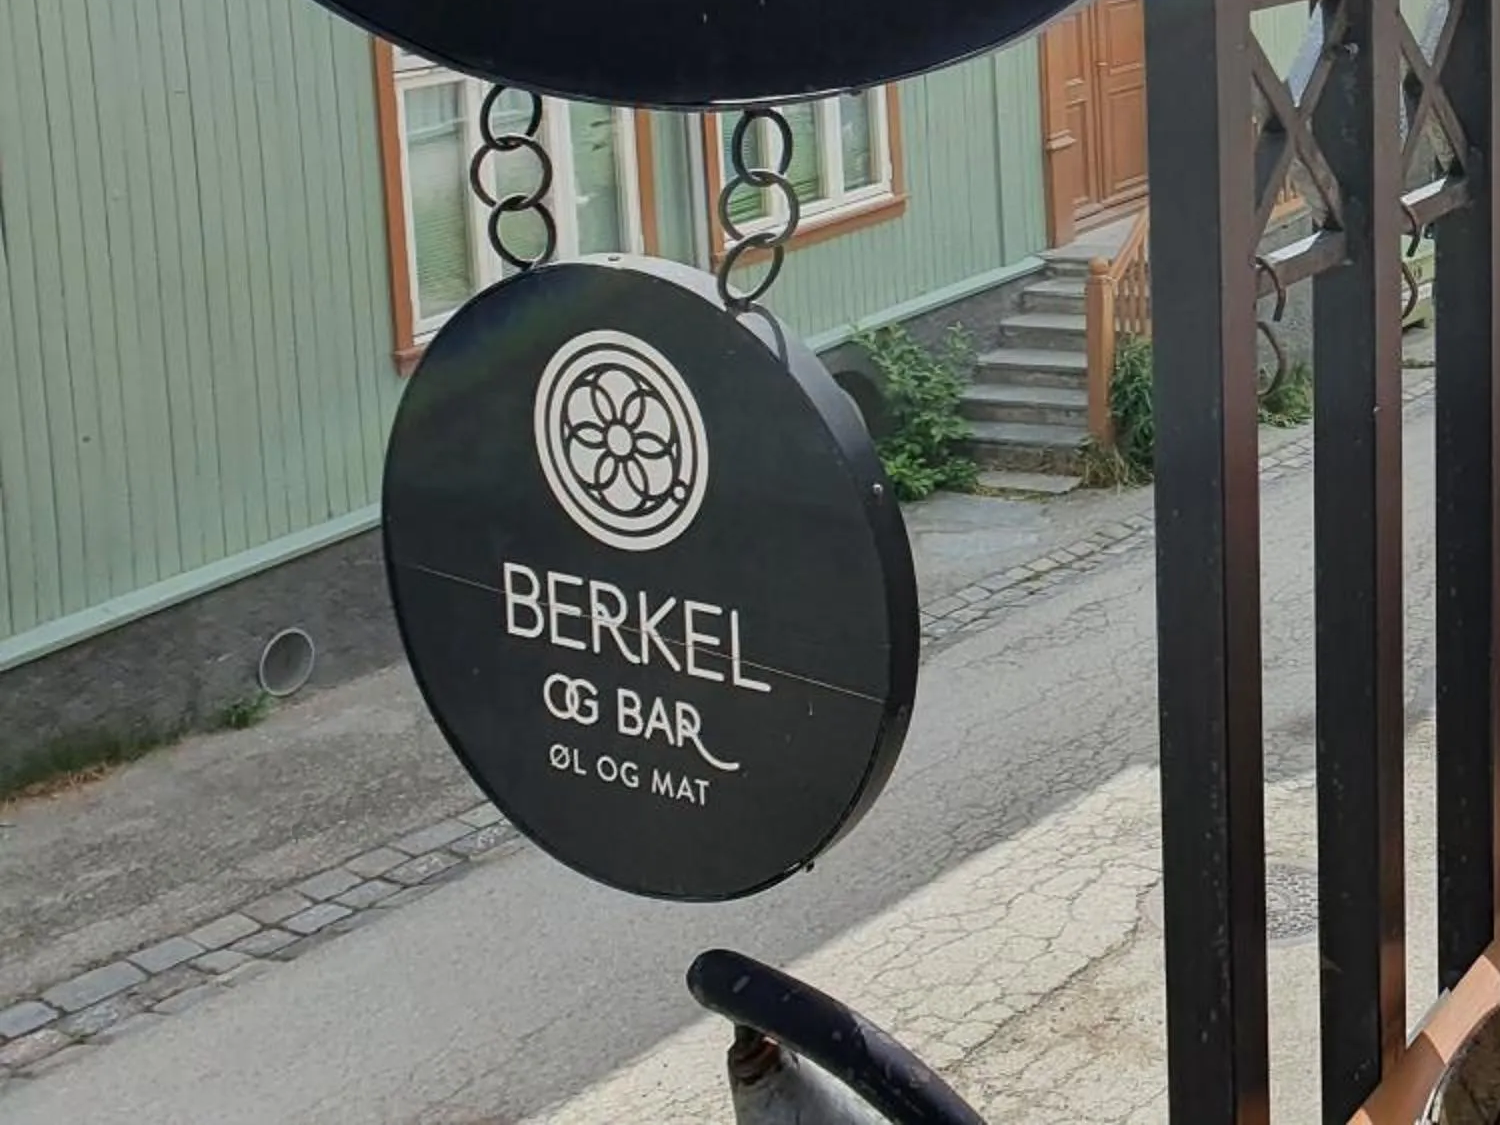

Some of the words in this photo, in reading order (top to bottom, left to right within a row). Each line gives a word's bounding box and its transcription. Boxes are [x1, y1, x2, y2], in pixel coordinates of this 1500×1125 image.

[503, 561, 772, 692] BERKEL
[543, 672, 600, 725] OG
[616, 687, 741, 771] BAR
[549, 743, 588, 777] ØL
[596, 755, 640, 789] OG
[651, 768, 710, 806] MAT
